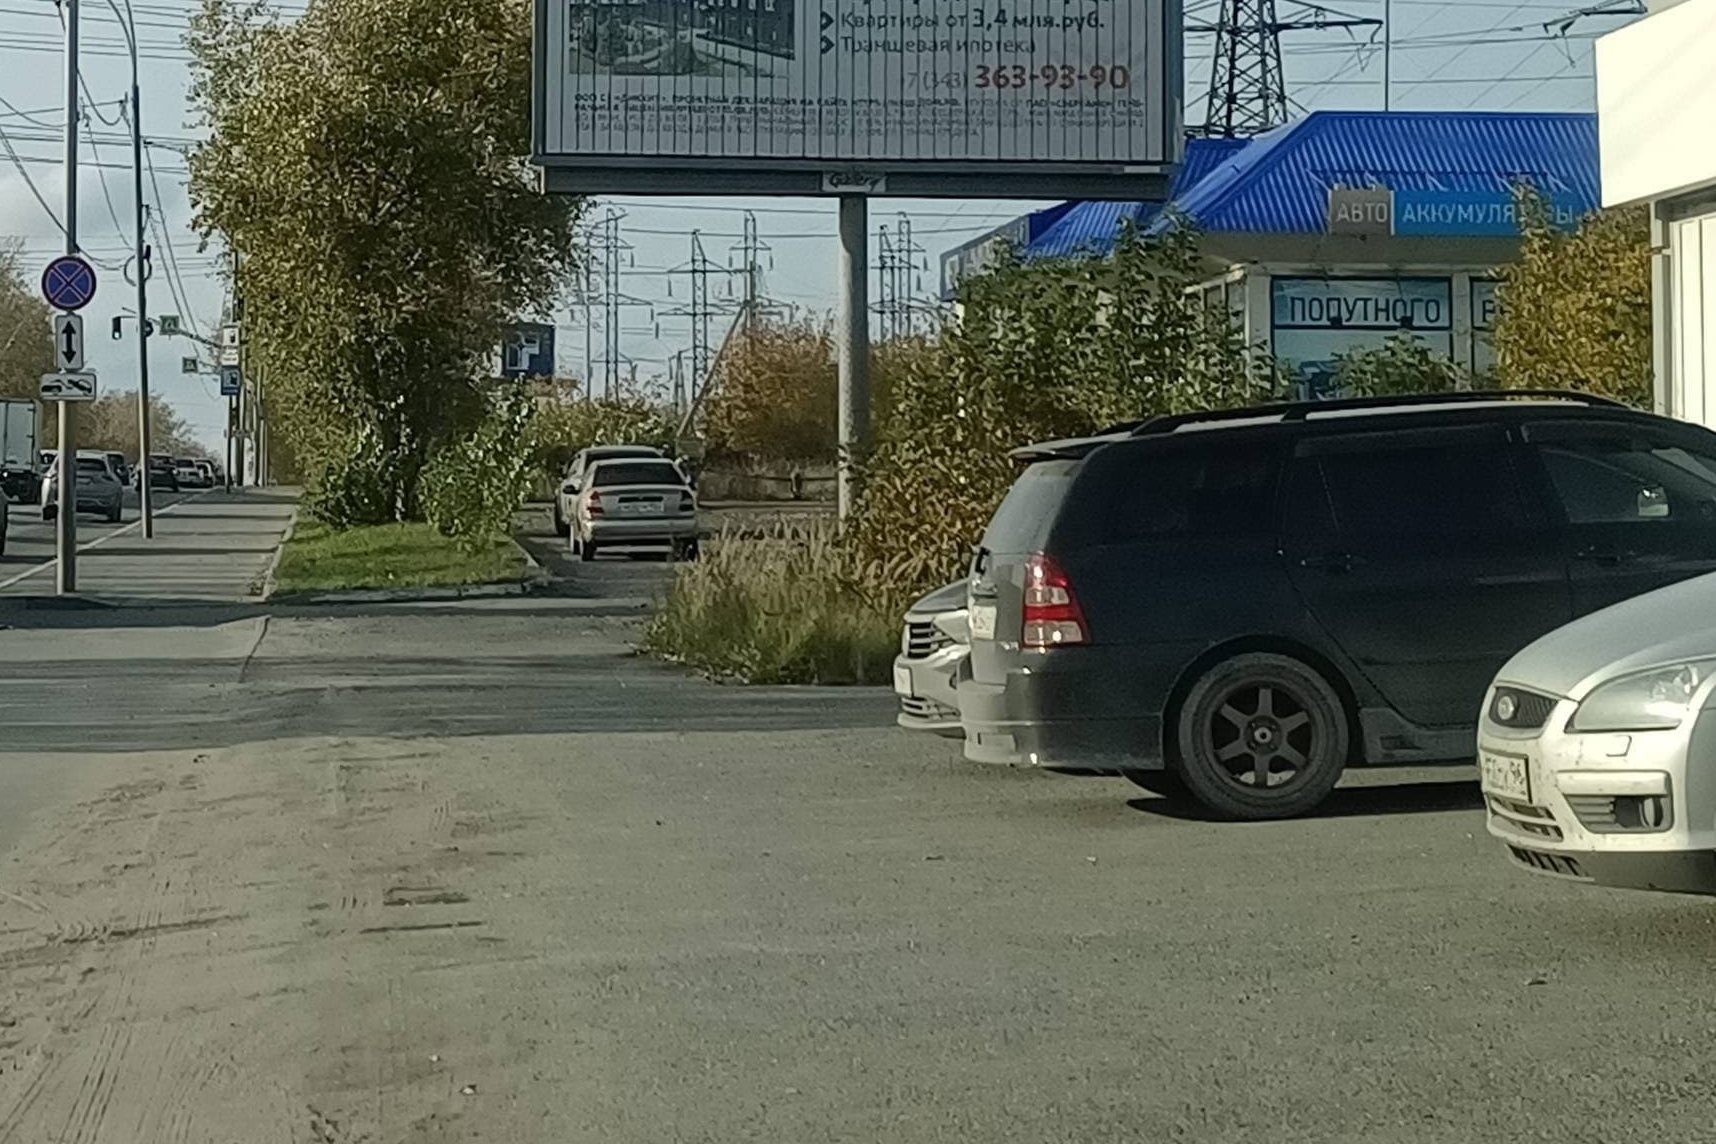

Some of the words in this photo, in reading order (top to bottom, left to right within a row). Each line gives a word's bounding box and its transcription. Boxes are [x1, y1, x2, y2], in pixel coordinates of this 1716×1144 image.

[840, 11, 939, 32] Квартиры
[944, 15, 969, 28] от
[971, 9, 1008, 32] 3,4
[974, 64, 1130, 90] 363-93-90
[1336, 203, 1388, 223] АВТО
[1290, 294, 1441, 324] ПОПУТНОГО
